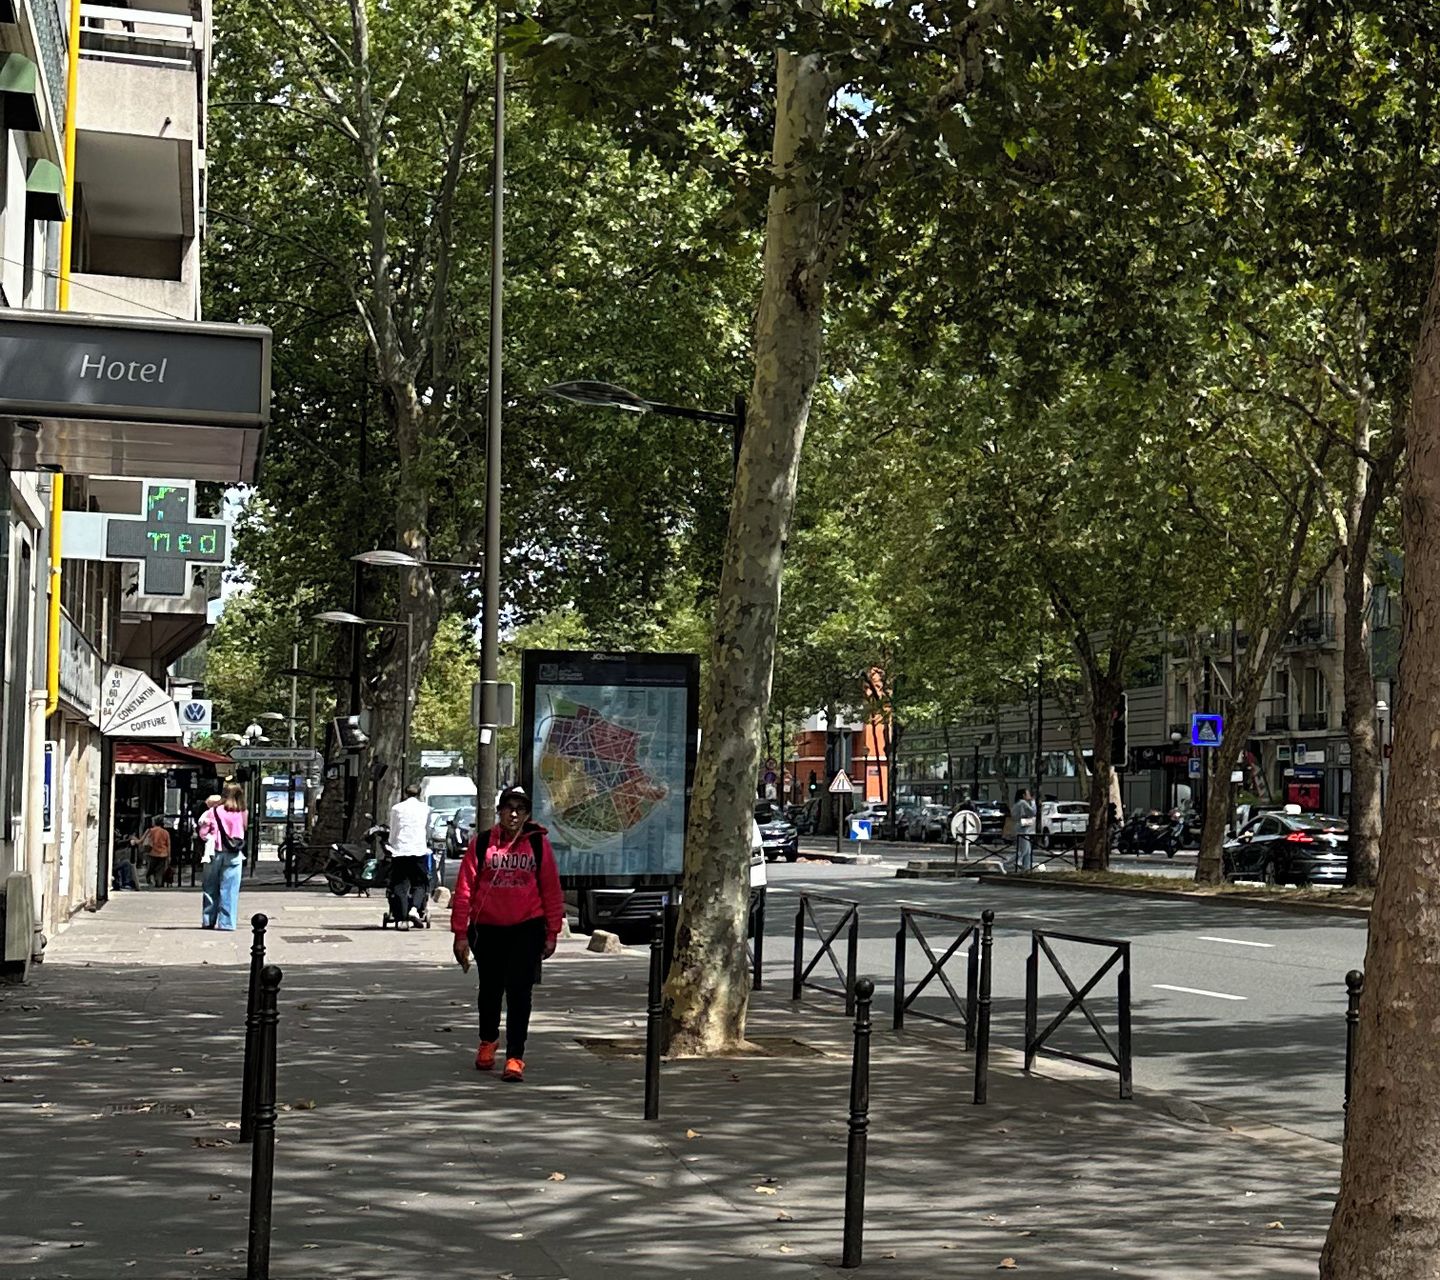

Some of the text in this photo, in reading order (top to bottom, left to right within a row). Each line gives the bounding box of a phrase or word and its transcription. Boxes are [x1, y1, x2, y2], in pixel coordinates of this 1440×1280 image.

[79, 354, 168, 383] Hotel
[118, 686, 156, 721] CONSTANTIN
[130, 716, 167, 732] COIFFURE
[1192, 761, 1200, 771] P
[482, 852, 538, 872] ONDON
